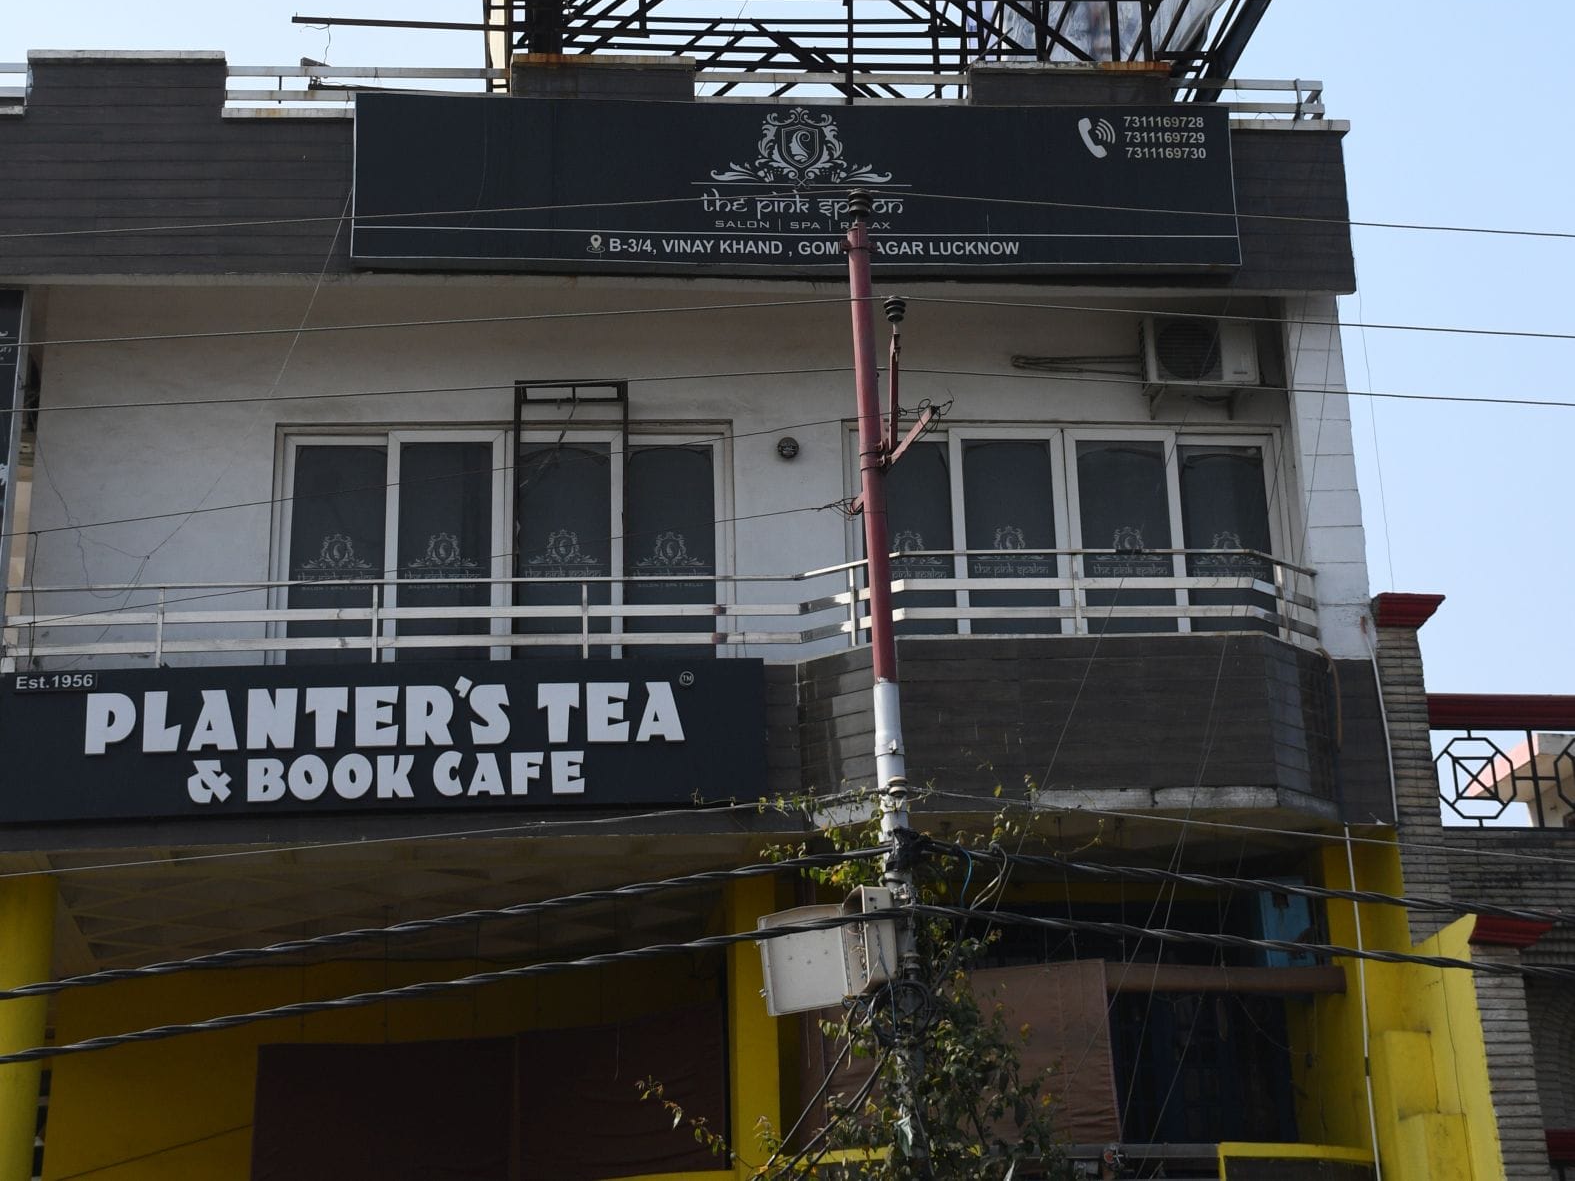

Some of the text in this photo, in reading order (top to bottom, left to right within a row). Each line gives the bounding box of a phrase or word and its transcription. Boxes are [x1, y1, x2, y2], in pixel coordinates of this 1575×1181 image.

[1123, 116, 1204, 128] 7311169728
[1124, 131, 1205, 144] 7311169729
[1125, 146, 1207, 159] 7311169730
[702, 188, 748, 212] the
[755, 190, 810, 219] pink
[715, 220, 770, 229] SALON
[790, 221, 821, 229] SPA
[609, 237, 657, 256] B-3/4,
[661, 239, 715, 254] VINAY
[719, 239, 783, 255] KHAND
[873, 241, 925, 255] AGAR
[929, 241, 1020, 255] LUCKNOW
[15, 673, 93, 690] Est.1956
[84, 675, 511, 755] PLANTER'S
[537, 681, 686, 743] TEA
[186, 750, 586, 803] & BOOK CAFE
